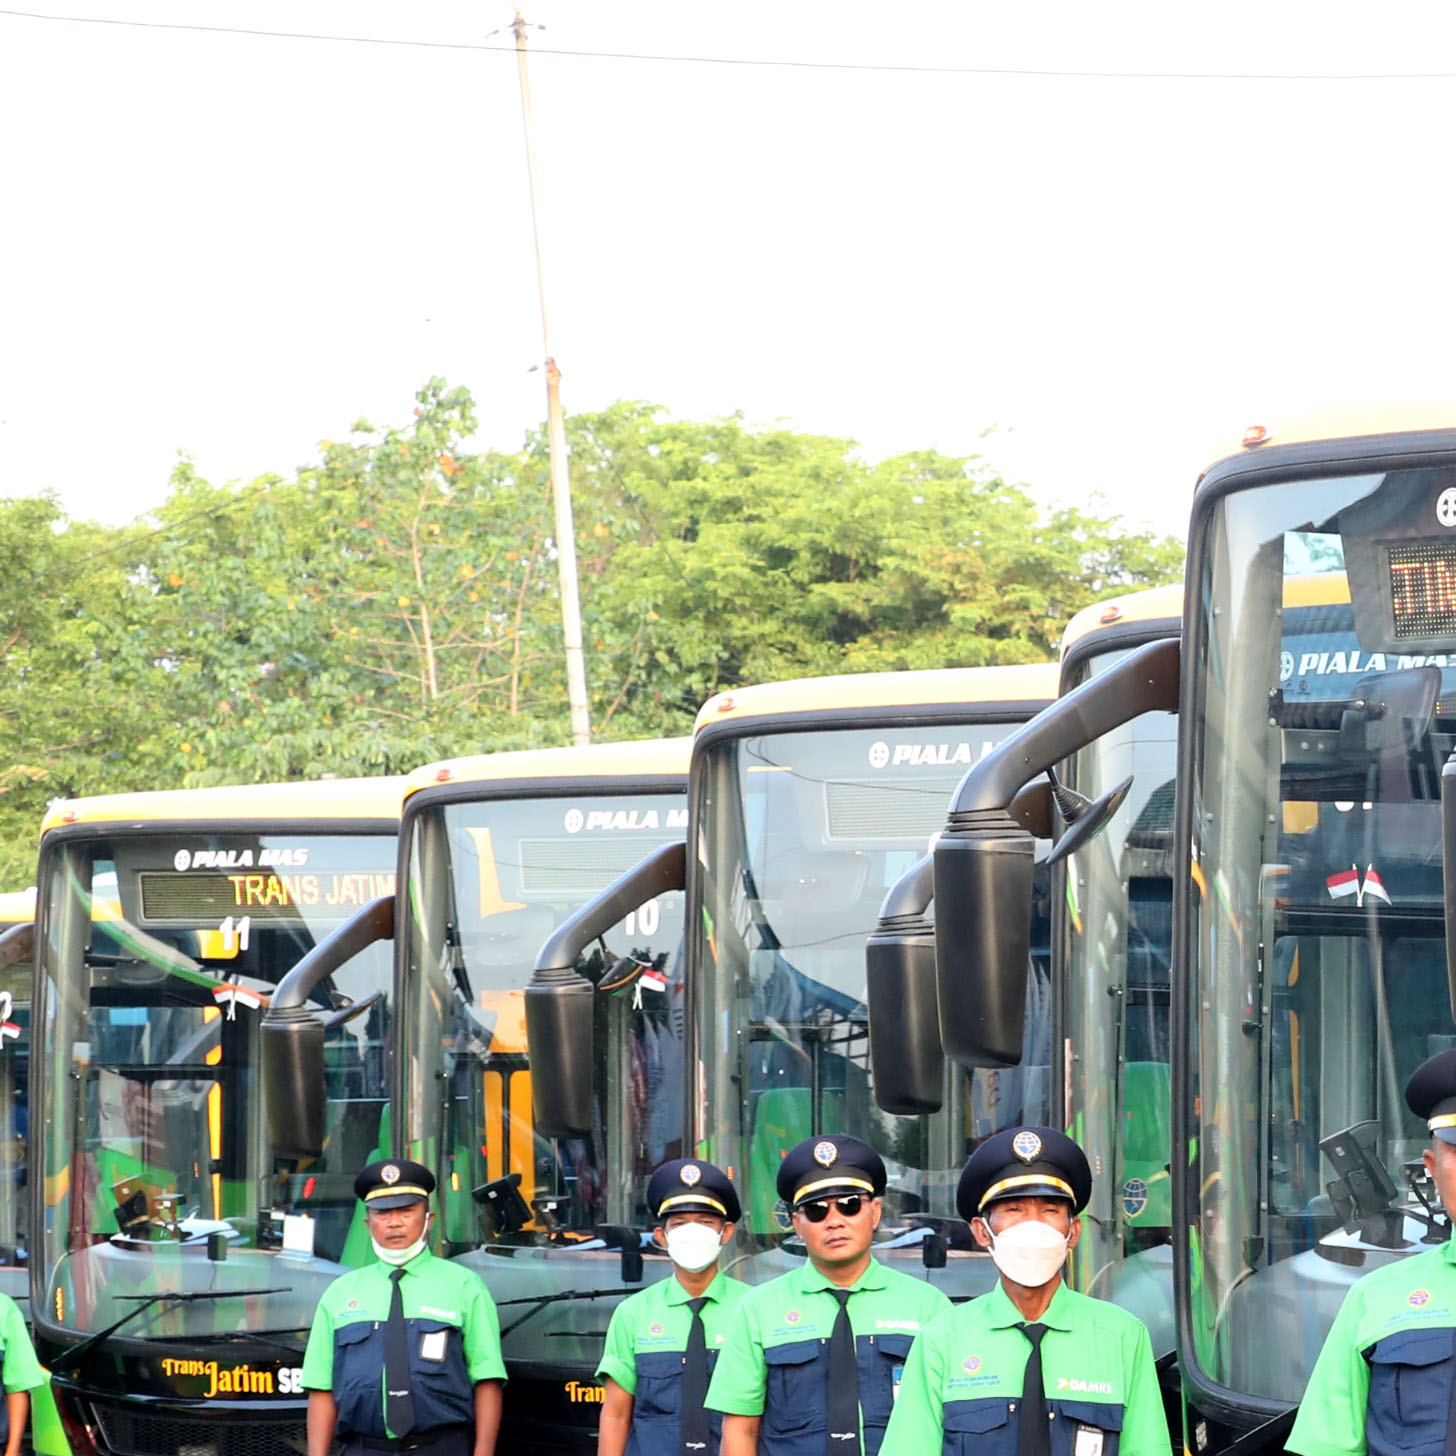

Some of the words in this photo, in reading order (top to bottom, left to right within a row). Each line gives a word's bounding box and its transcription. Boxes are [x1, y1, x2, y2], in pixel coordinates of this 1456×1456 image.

[1298, 650, 1387, 676] PIALA
[892, 743, 972, 765] PIALA
[586, 810, 660, 830] PIALA
[192, 850, 253, 869] PIALA
[258, 848, 309, 867] MAS
[227, 874, 320, 906] TRANS
[326, 873, 397, 904] JATIM
[219, 916, 250, 951] 11
[161, 1358, 206, 1376] Trans
[203, 1361, 274, 1398] Jatim
[1068, 1379, 1113, 1394] DAMRI
